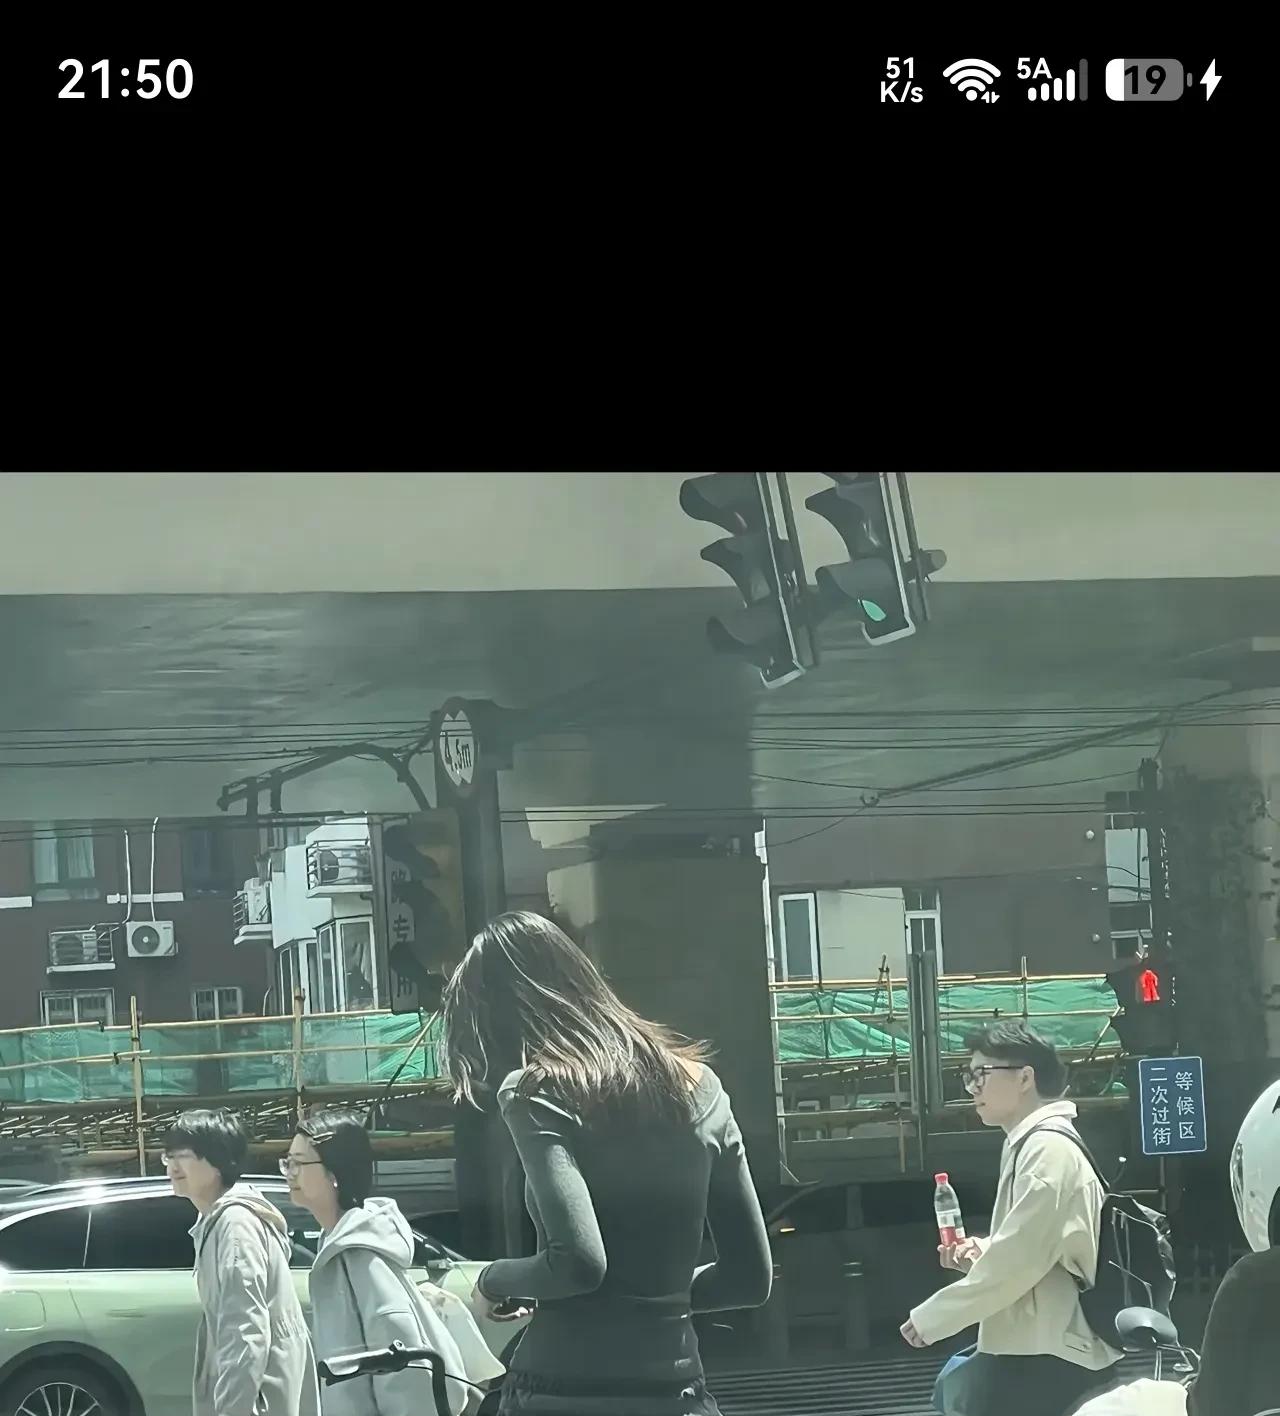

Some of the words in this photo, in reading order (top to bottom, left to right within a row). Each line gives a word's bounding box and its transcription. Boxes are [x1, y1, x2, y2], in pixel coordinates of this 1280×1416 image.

[1150, 1067, 1171, 1147] 二次过街
[1174, 1071, 1196, 1140] 等候区
